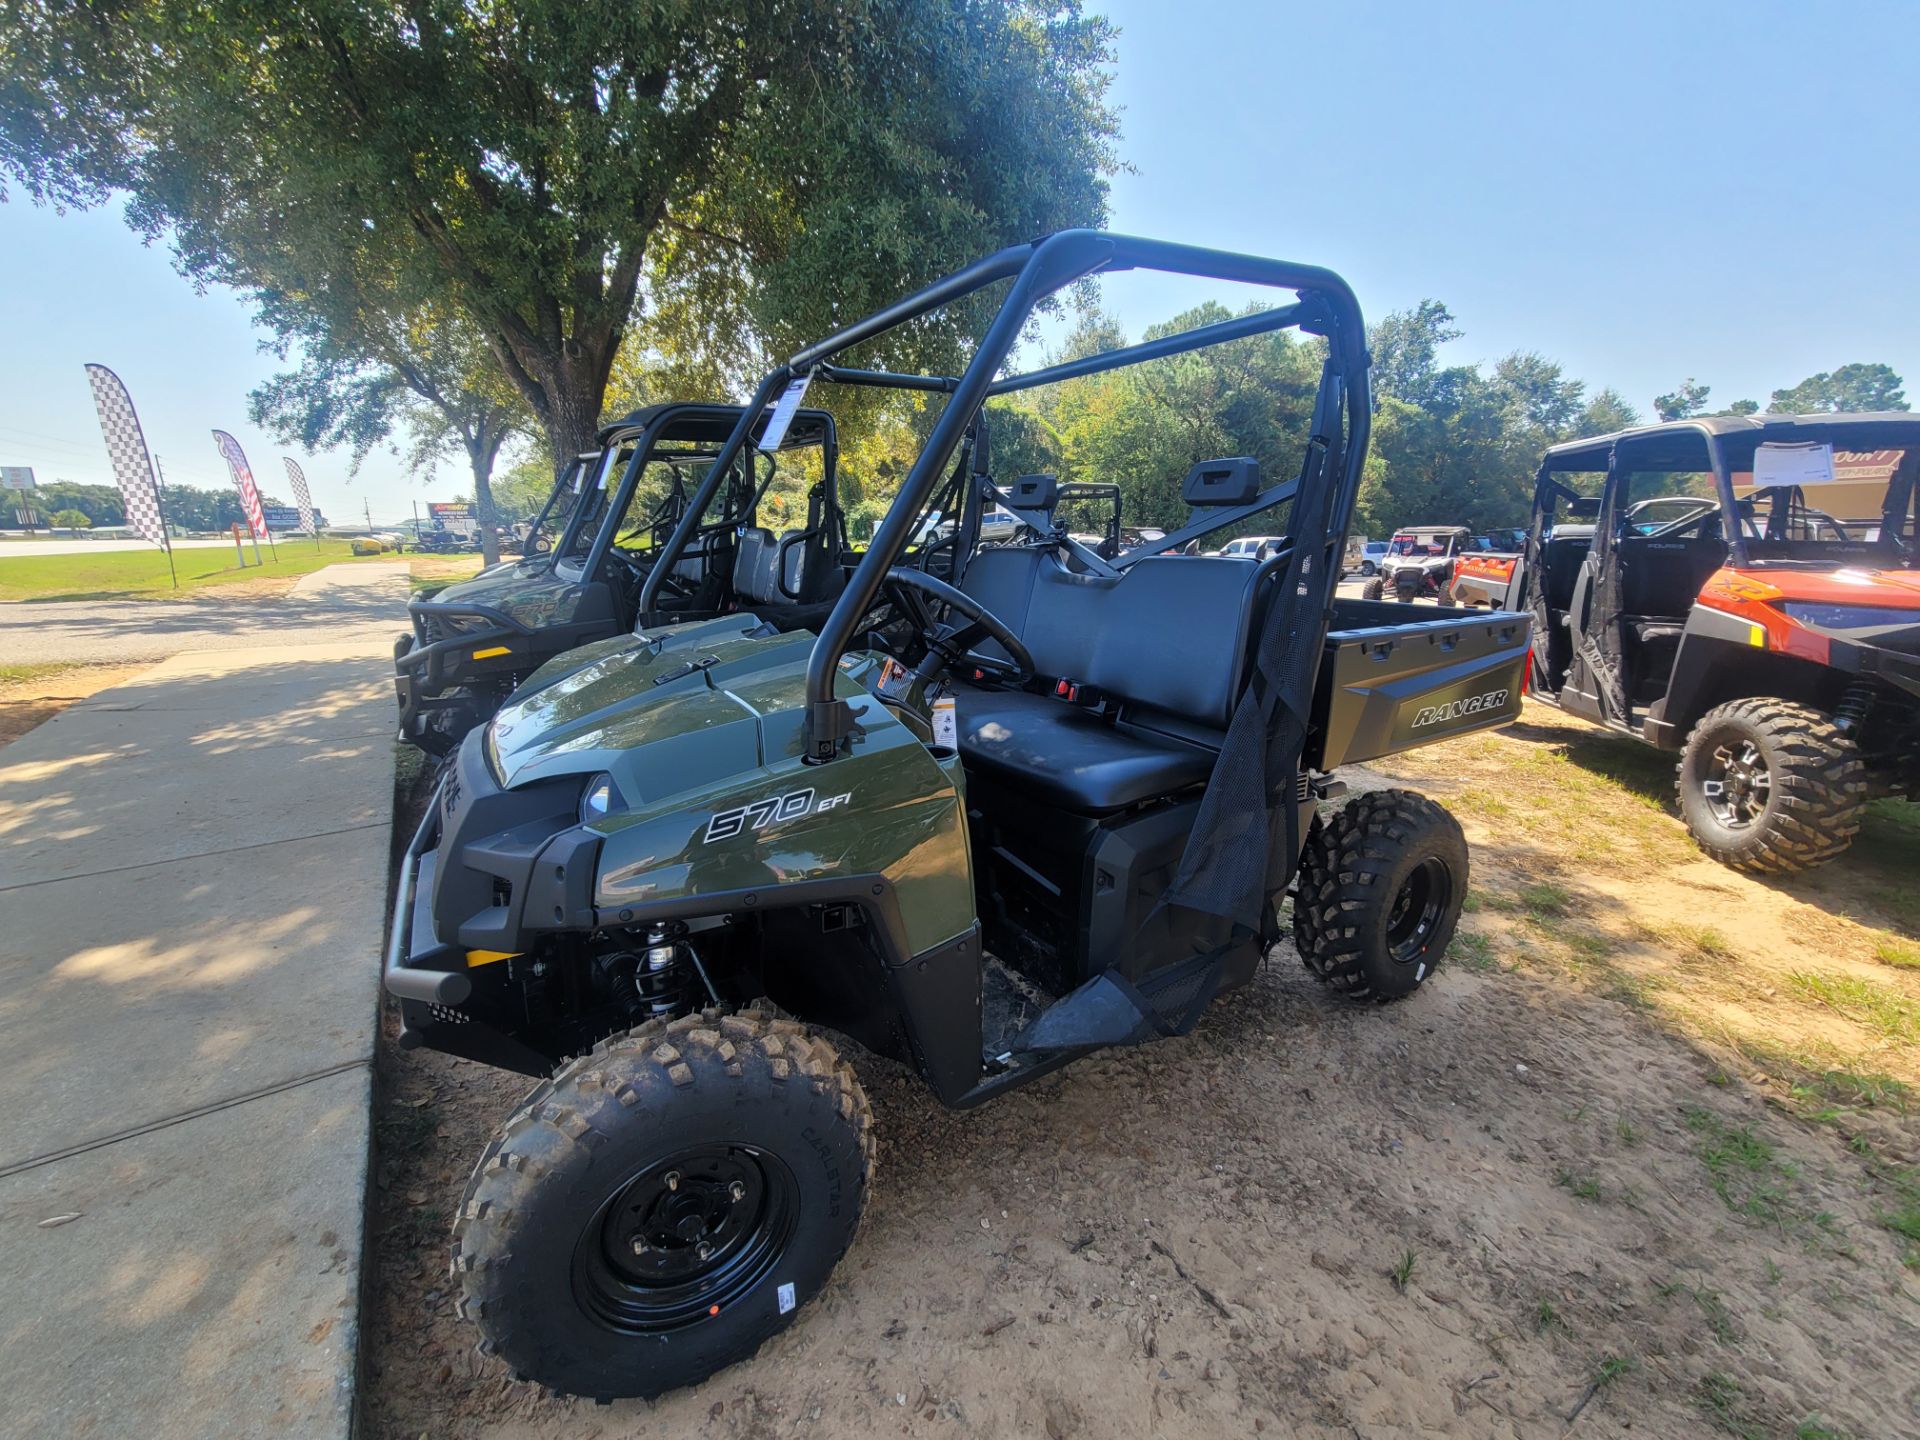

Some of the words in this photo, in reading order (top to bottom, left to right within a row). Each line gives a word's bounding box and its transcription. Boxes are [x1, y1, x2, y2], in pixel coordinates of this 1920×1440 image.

[1411, 689, 1508, 728] RANGER
[703, 787, 815, 844] 570
[817, 792, 851, 812] EFI
[801, 1127, 840, 1217] CARLSTAR
